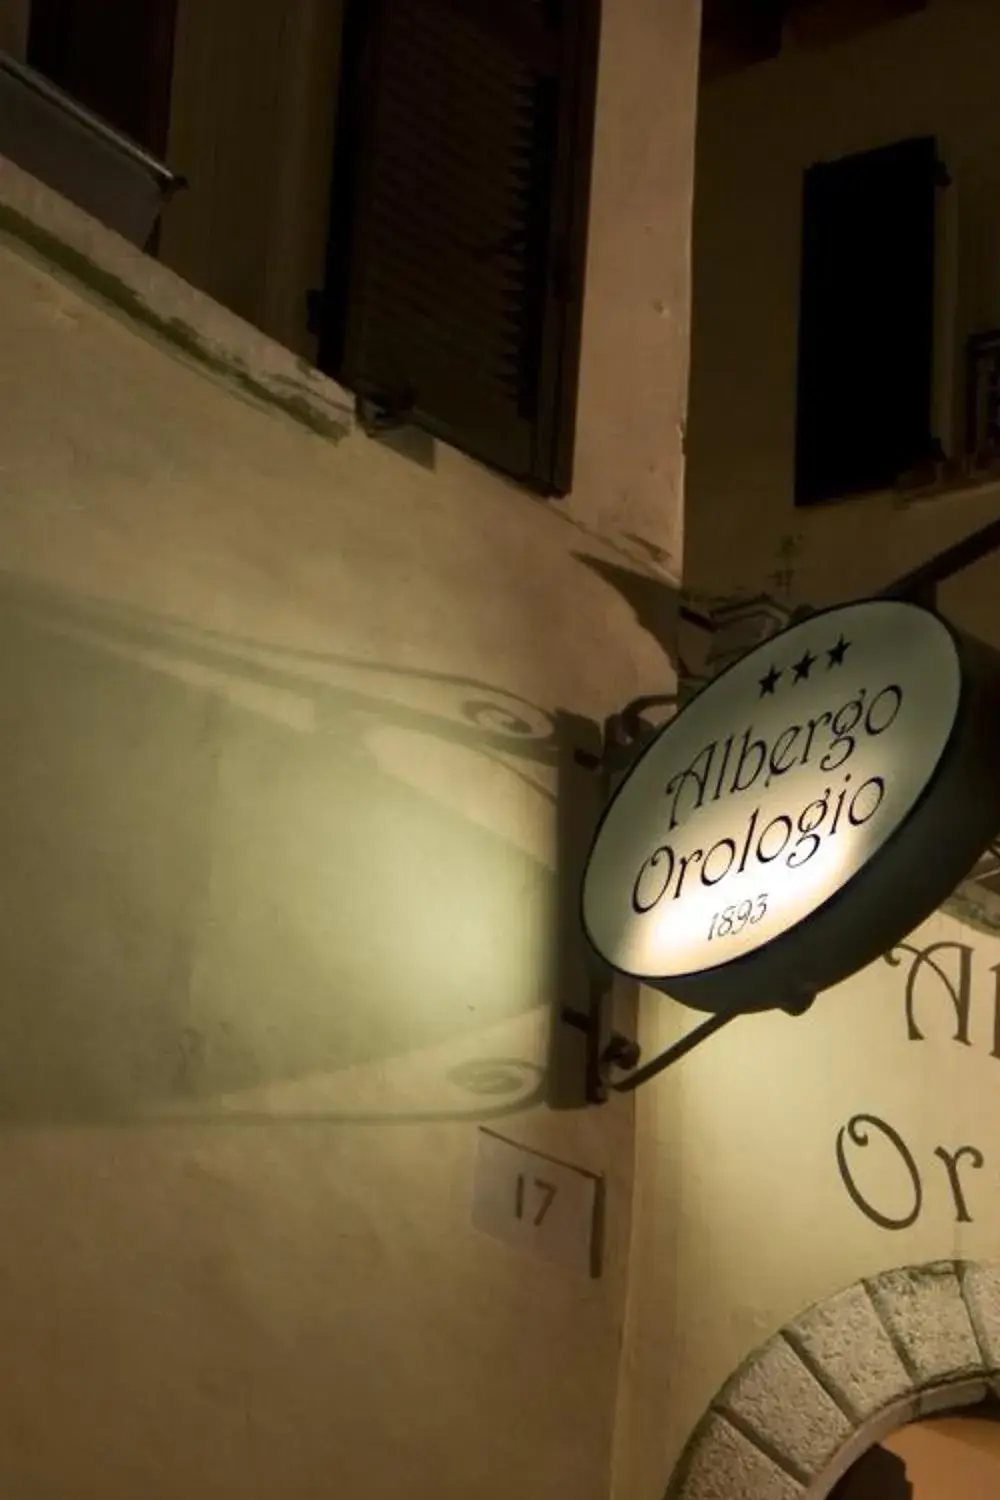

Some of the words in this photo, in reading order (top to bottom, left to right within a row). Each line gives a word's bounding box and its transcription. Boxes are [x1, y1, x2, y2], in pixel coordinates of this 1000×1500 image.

[666, 685, 902, 829] Albergo
[632, 774, 885, 913] Orologio
[707, 893, 769, 941] 1893
[515, 1173, 558, 1227] 17
